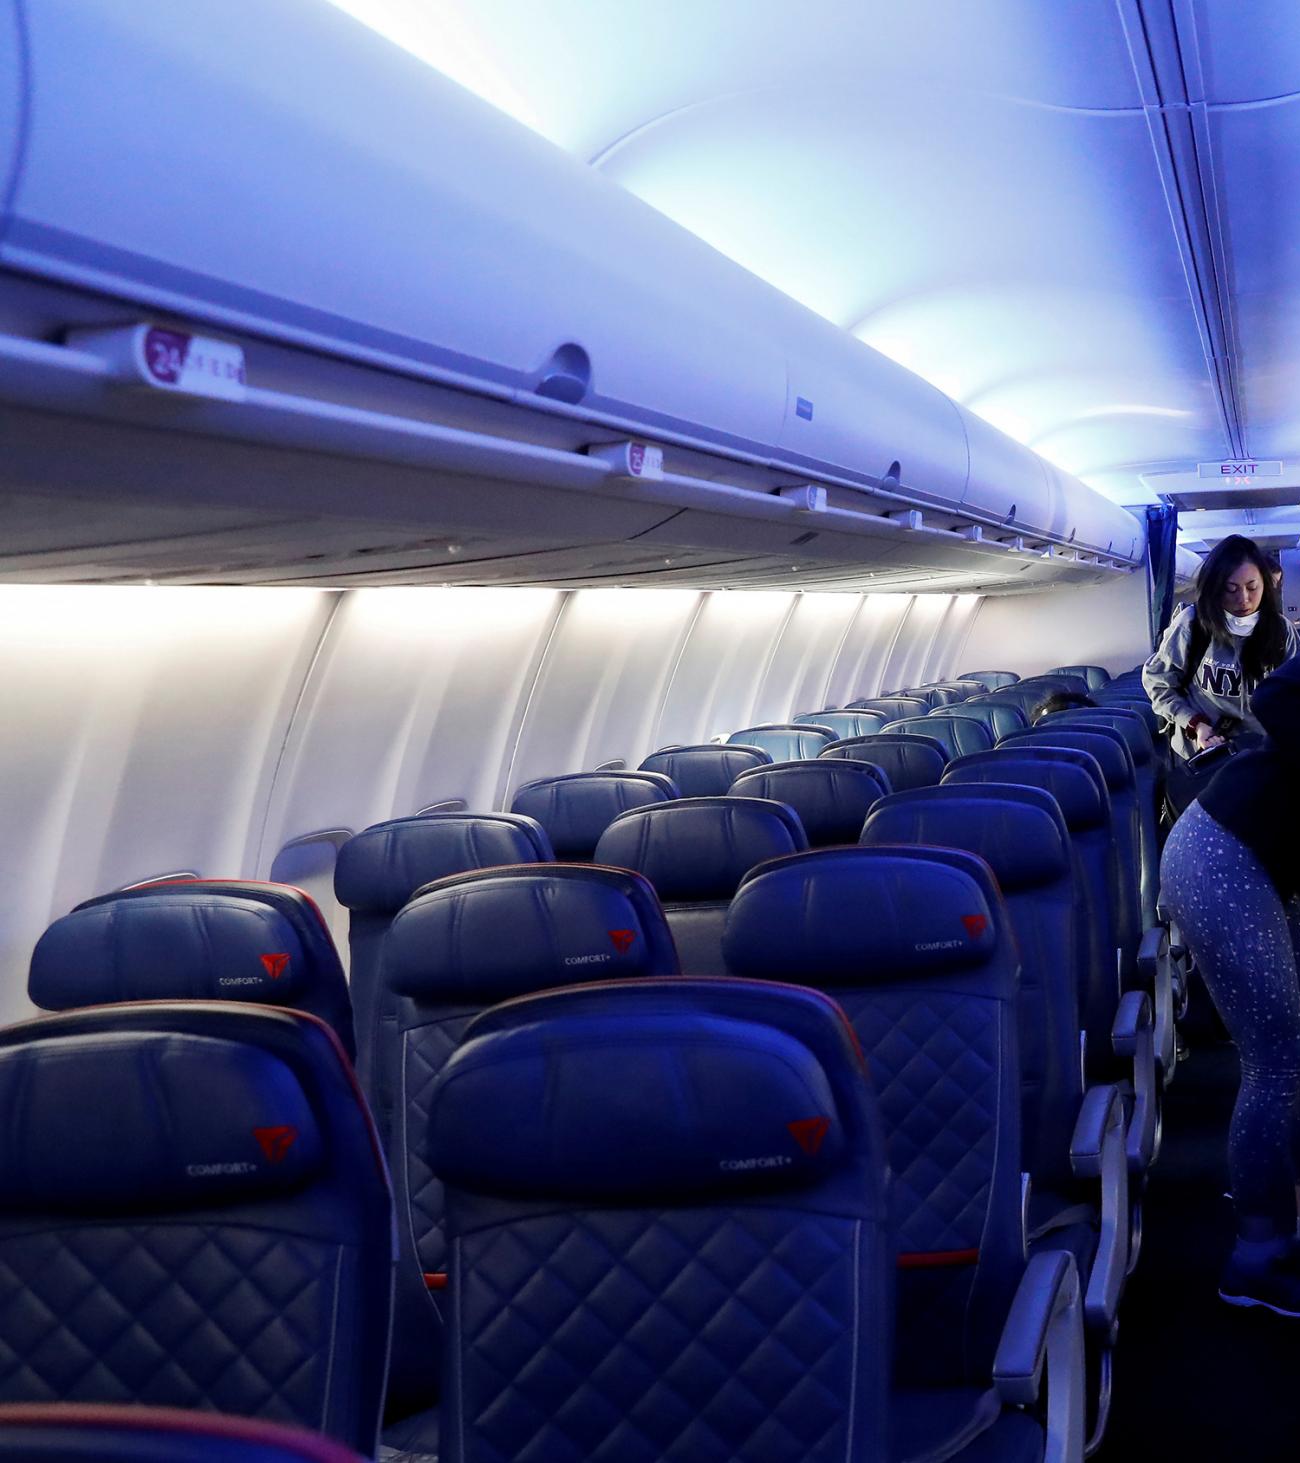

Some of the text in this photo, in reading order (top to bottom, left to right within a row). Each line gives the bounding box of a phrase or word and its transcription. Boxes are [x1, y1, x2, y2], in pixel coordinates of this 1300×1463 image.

[153, 343, 181, 375] 24
[1221, 464, 1258, 475] EXIT
[915, 939, 963, 951] COMFORT+
[565, 953, 611, 965] COMFORT+
[219, 976, 263, 986] COMFORT+
[719, 1154, 792, 1171] COMFORT+
[187, 1161, 257, 1177] COMFORT+
